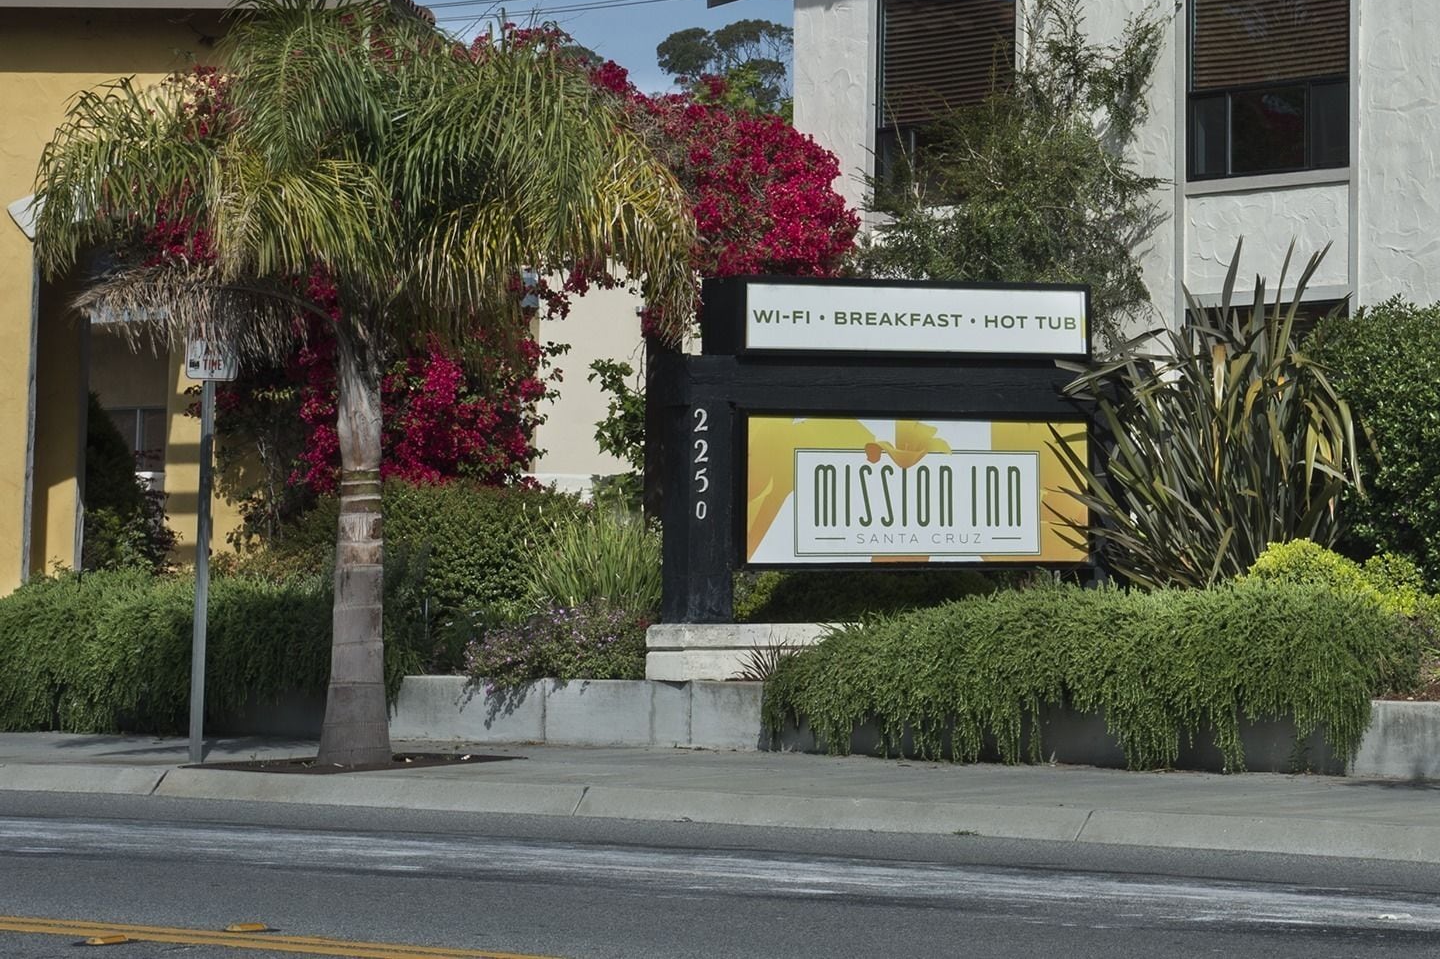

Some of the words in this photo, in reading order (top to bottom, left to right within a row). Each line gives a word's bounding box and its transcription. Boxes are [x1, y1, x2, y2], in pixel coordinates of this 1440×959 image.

[753, 309, 810, 325] WI-FI
[834, 311, 963, 328] BREAKFAST
[984, 314, 1028, 330] HOT
[1035, 316, 1077, 330] TUB
[203, 358, 222, 371] TIME
[693, 408, 709, 520] 2250
[814, 464, 953, 527] MISSION
[971, 465, 1021, 527] INN
[856, 533, 920, 544] SANTA
[931, 533, 982, 544] CRUZ
